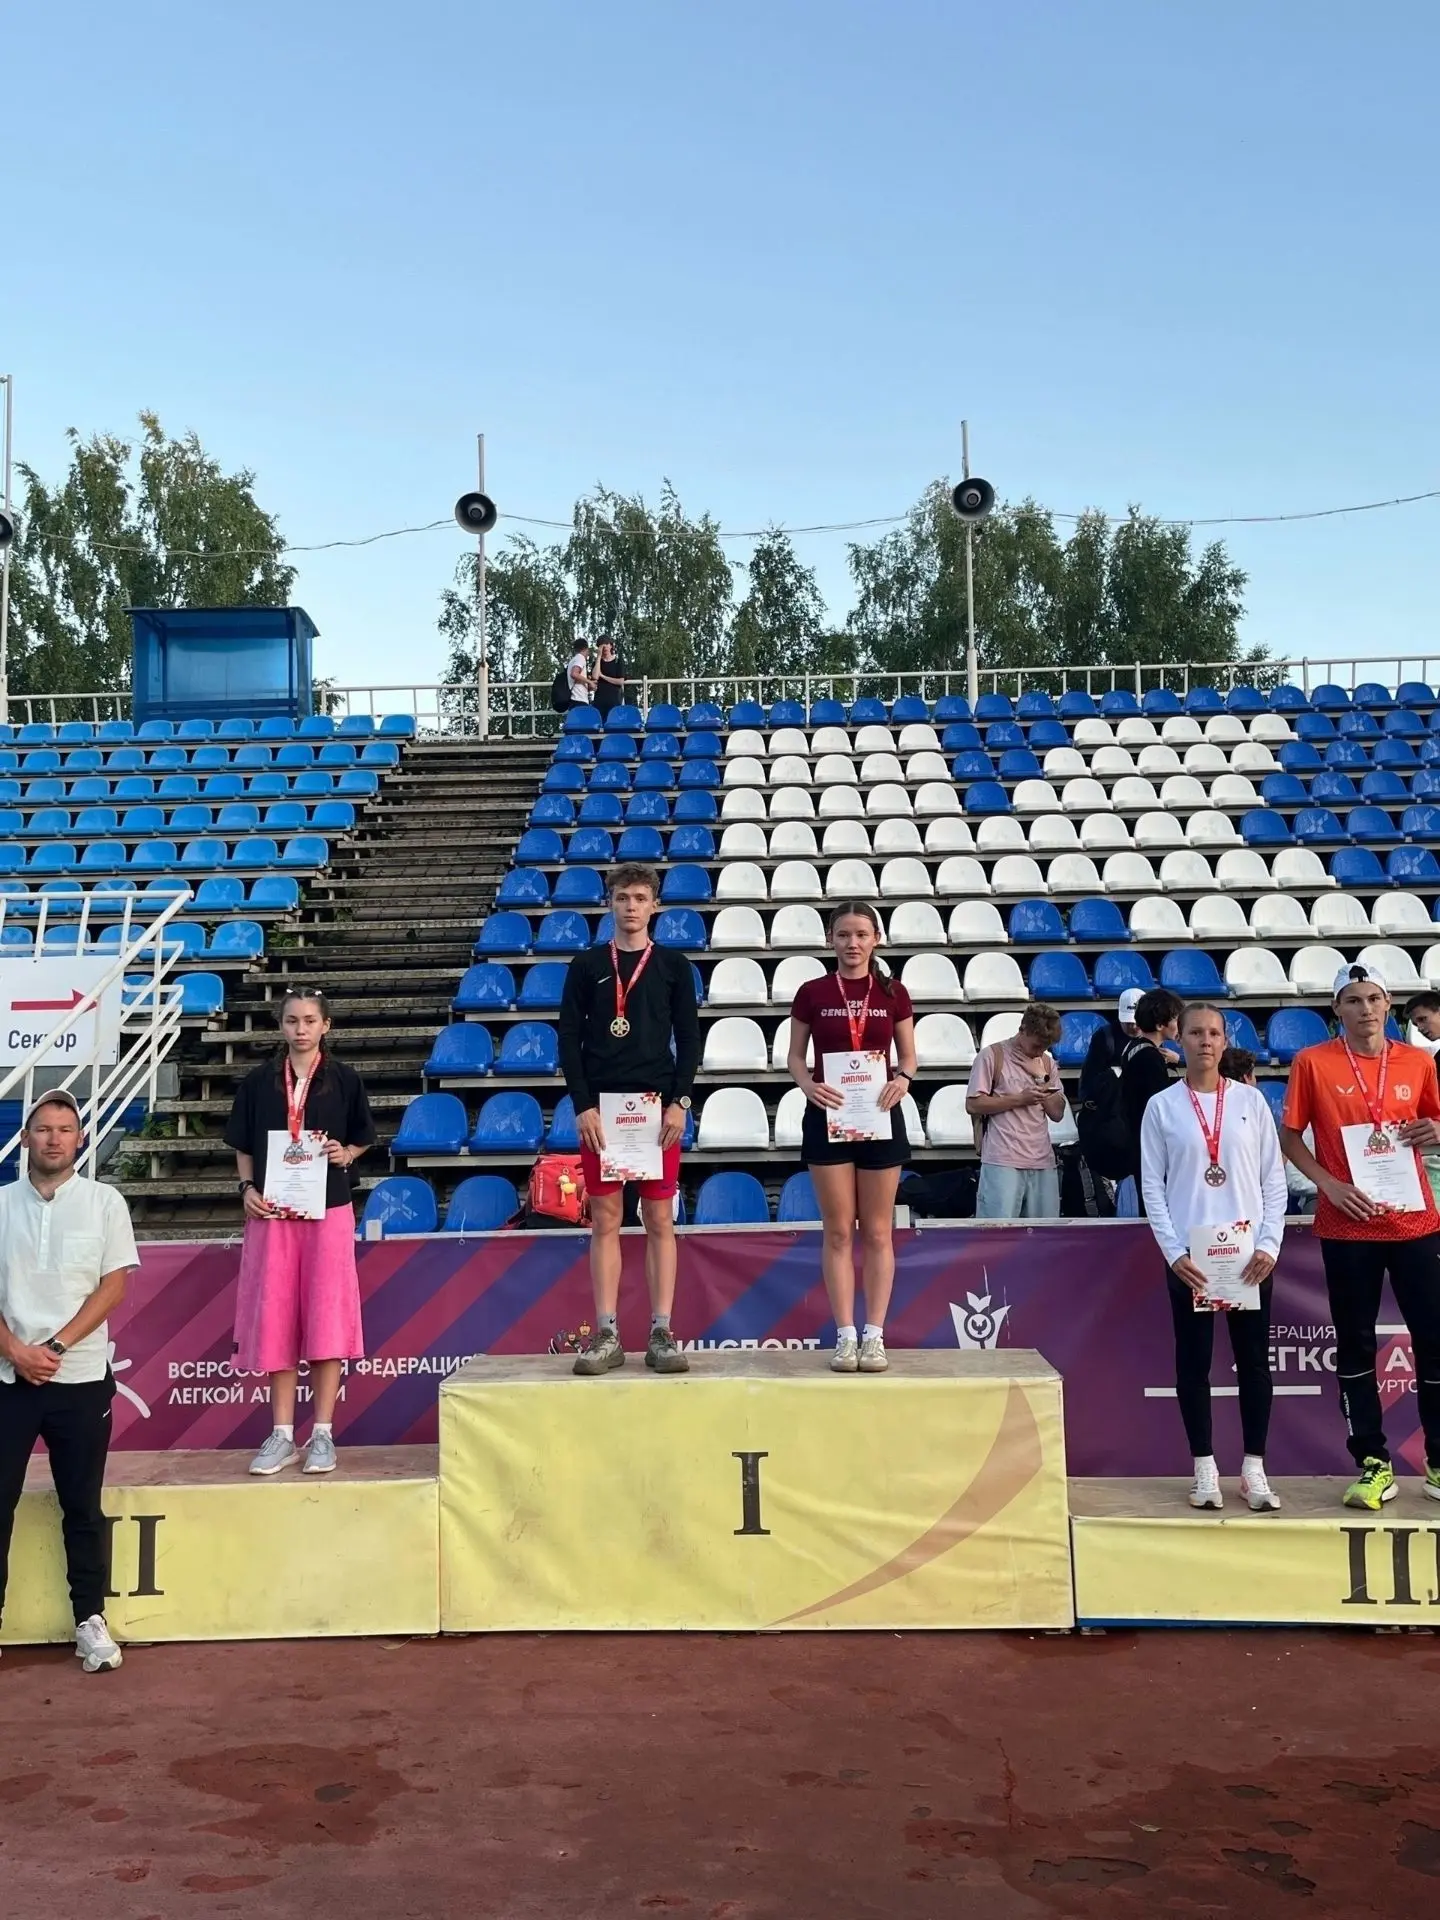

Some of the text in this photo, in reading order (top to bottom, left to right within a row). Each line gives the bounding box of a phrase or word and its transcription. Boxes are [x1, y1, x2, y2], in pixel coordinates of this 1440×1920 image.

[841, 1074, 872, 1085] ДИПЛОМ
[615, 1116, 647, 1125] ДИПЛОМ
[1207, 1246, 1240, 1257] ДИПЛОМ
[168, 1382, 244, 1404] ЛЕГКОЙ
[732, 1452, 770, 1535] I
